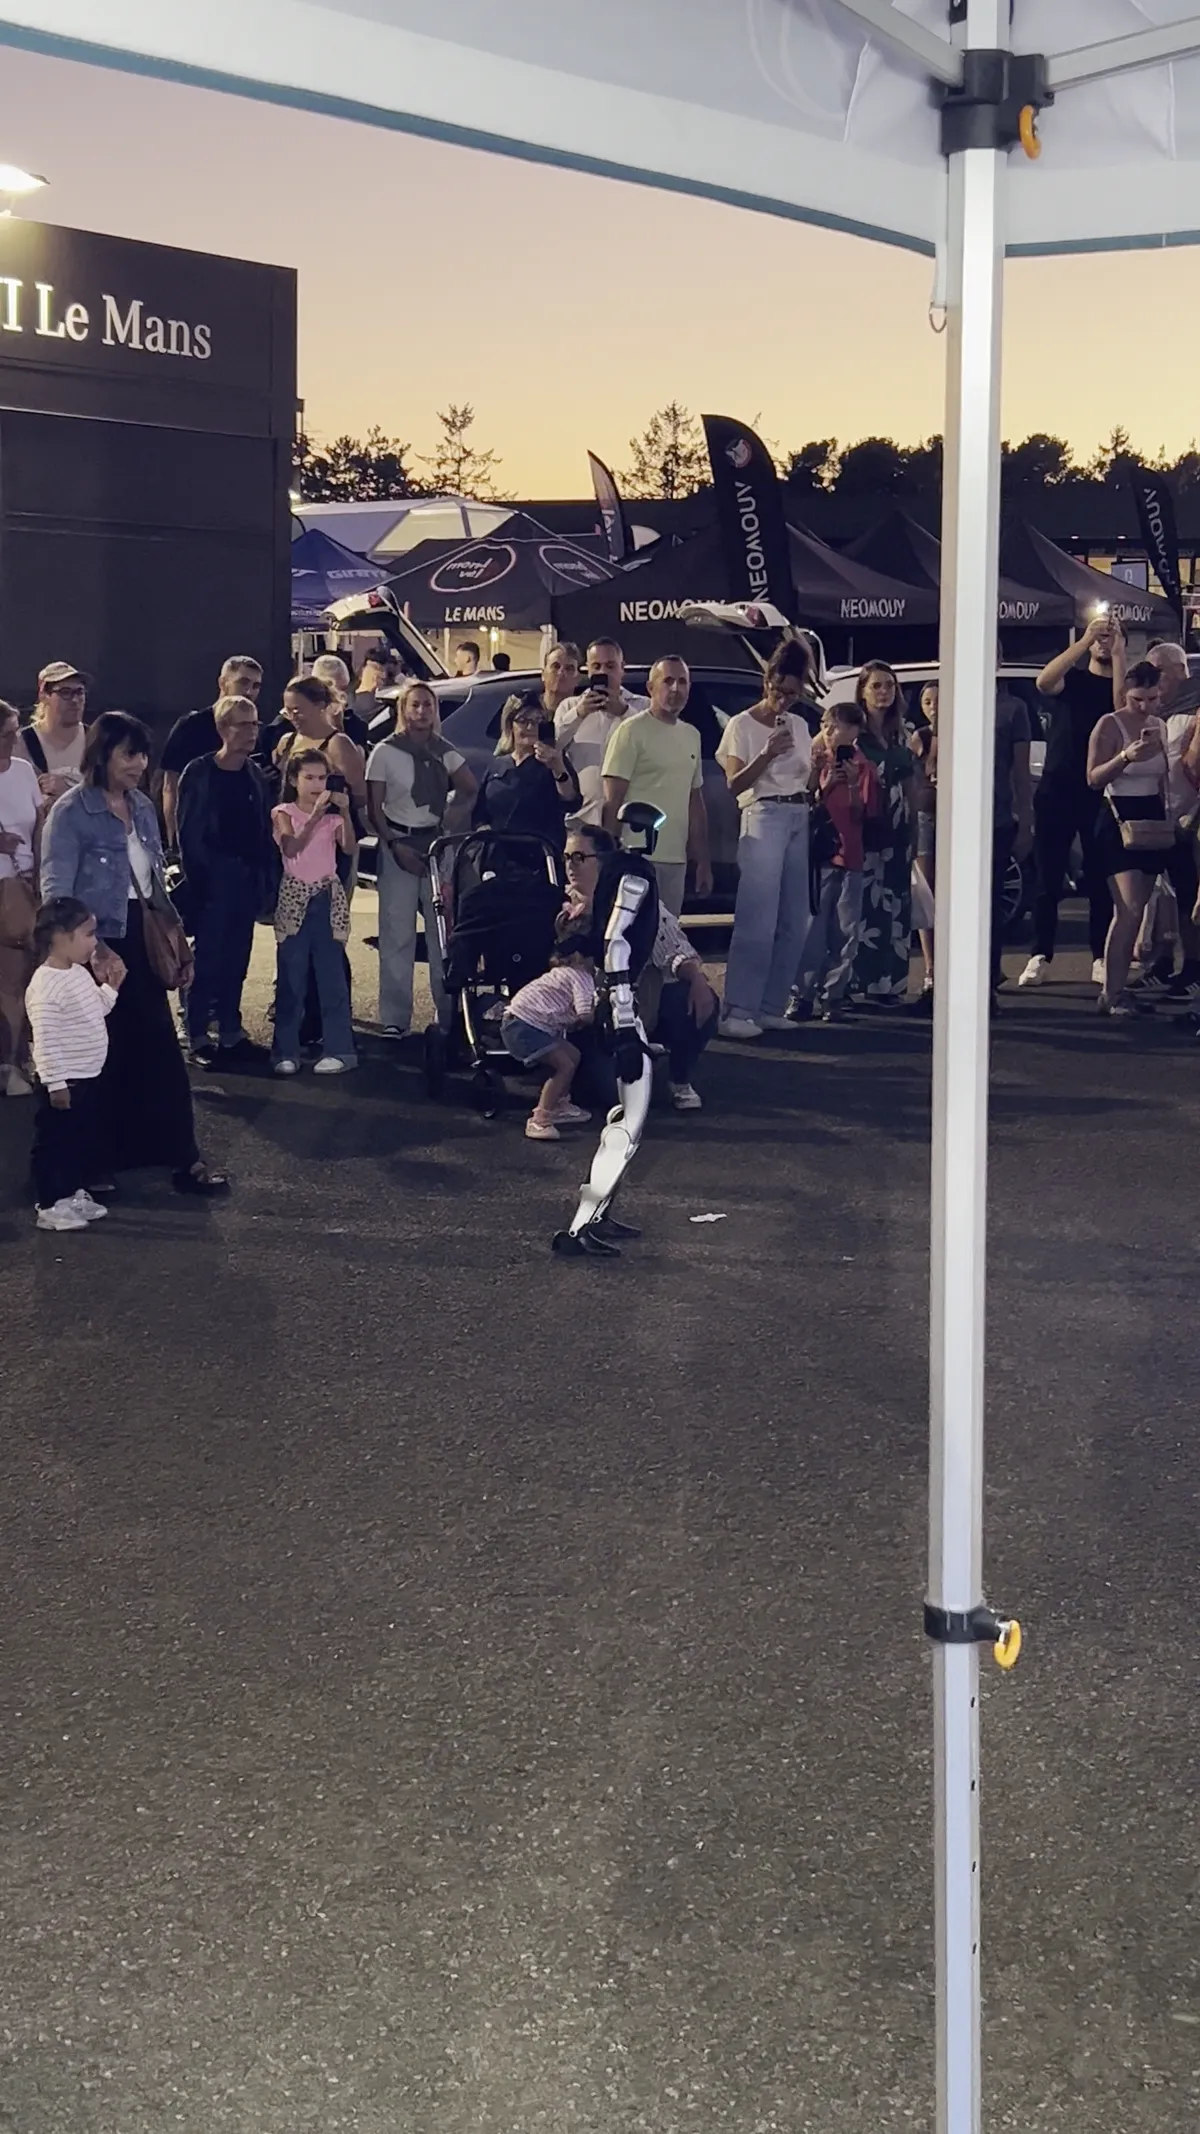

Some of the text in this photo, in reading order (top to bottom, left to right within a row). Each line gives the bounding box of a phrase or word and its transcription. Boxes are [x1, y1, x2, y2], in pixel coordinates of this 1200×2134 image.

[34, 281, 90, 341] Le
[101, 293, 212, 360] Mans
[734, 481, 770, 602] NEOMOUY
[444, 605, 506, 622] LE MANS
[620, 599, 726, 622] NEOM
[841, 598, 906, 619] NEOMOUY
[999, 601, 1040, 619] OMOUY
